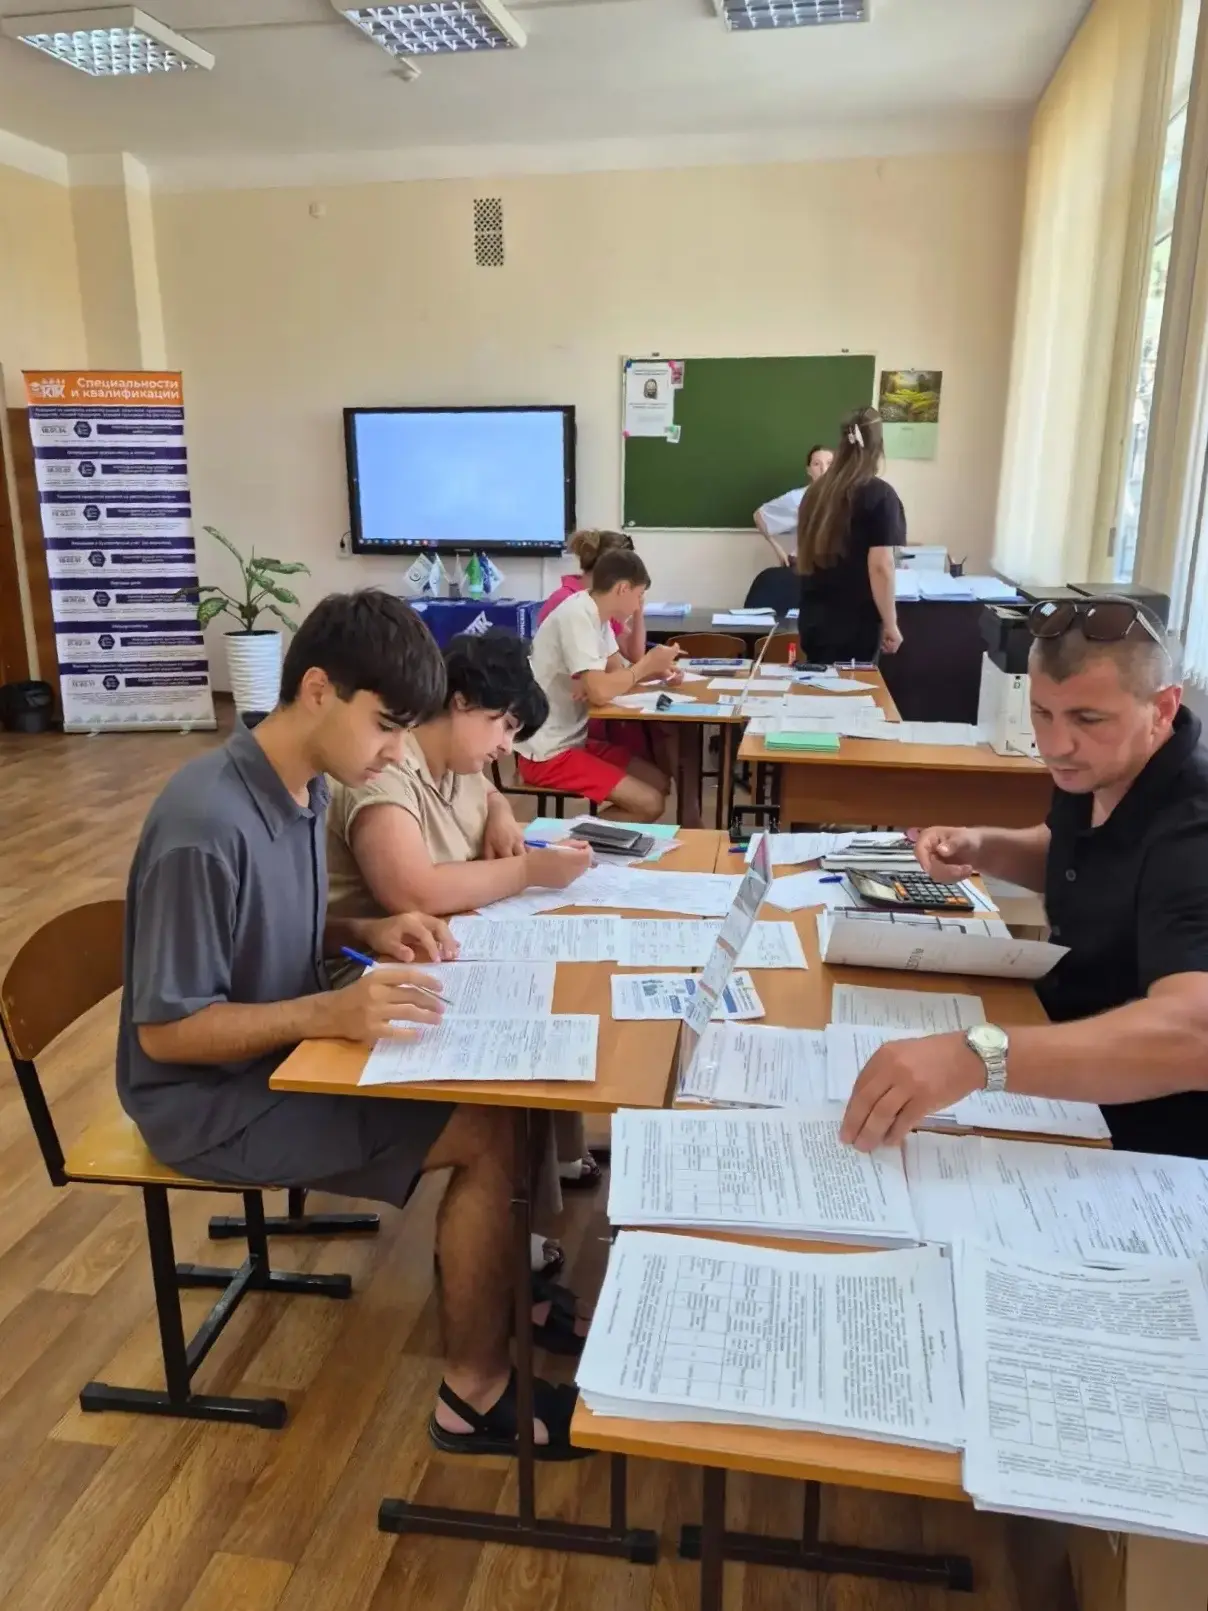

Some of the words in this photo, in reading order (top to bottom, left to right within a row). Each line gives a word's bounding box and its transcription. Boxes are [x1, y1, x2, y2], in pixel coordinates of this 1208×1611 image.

[77, 378, 178, 389] Специальности
[71, 389, 79, 398] и
[83, 388, 180, 401] квалификации
